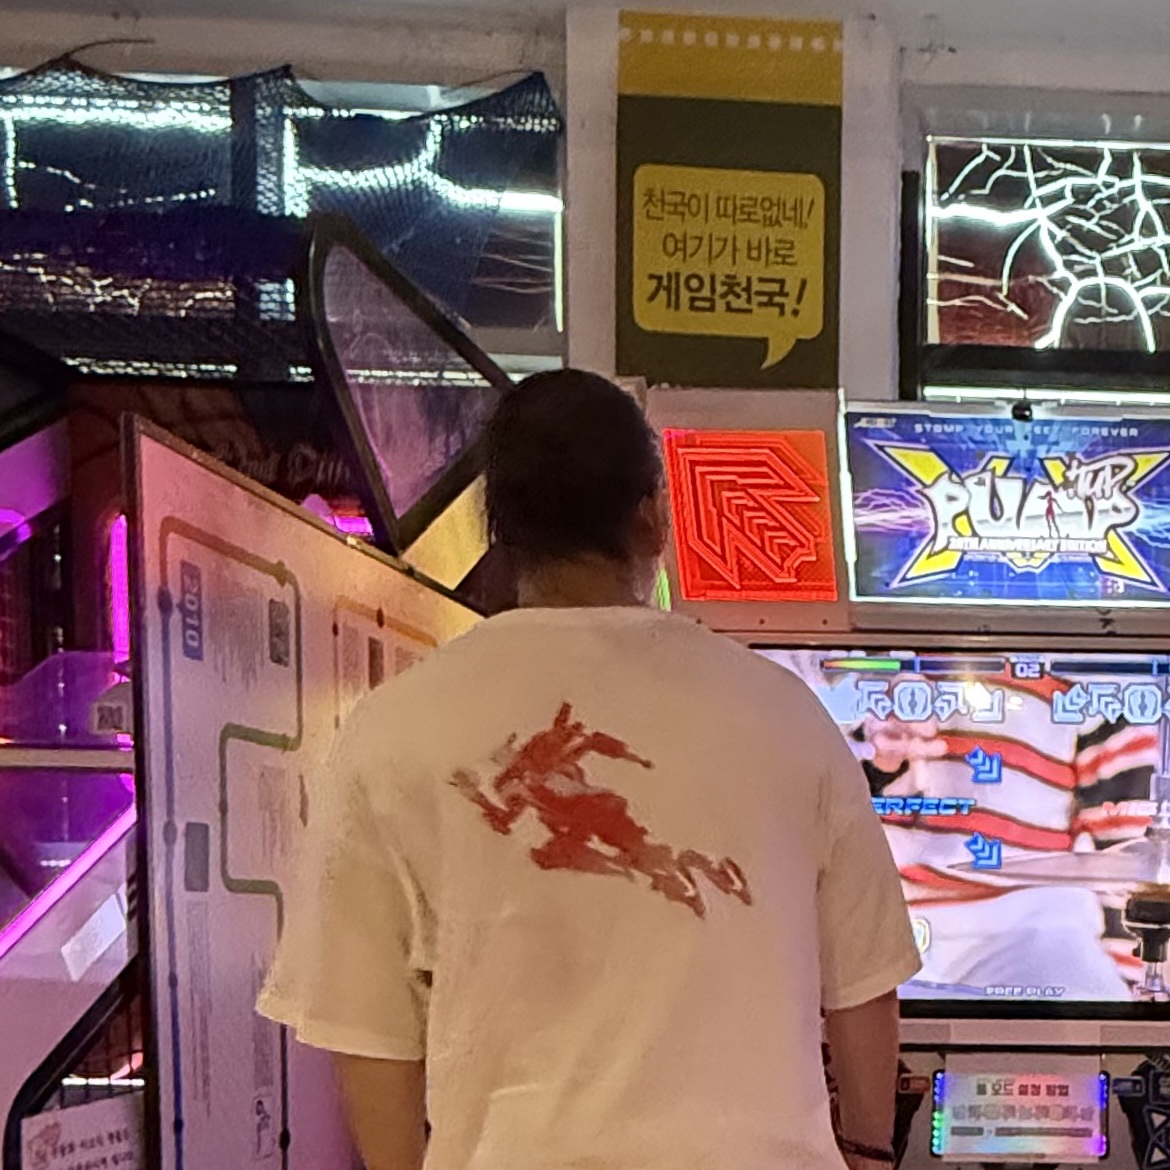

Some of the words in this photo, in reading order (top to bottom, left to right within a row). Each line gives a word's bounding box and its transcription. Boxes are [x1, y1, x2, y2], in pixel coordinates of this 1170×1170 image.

[642, 187, 710, 224] 천국이
[716, 190, 815, 229] 따로없네!
[662, 231, 740, 266] 여기가
[746, 234, 798, 267] 바로
[646, 271, 808, 318] 게임천국!
[1072, 427, 1139, 438] FOREVER
[918, 468, 1140, 554] PUMP
[183, 571, 200, 649] 2010
[1015, 662, 1041, 678] 02
[871, 797, 976, 816] ERFECT
[1026, 986, 1065, 997] PLAY
